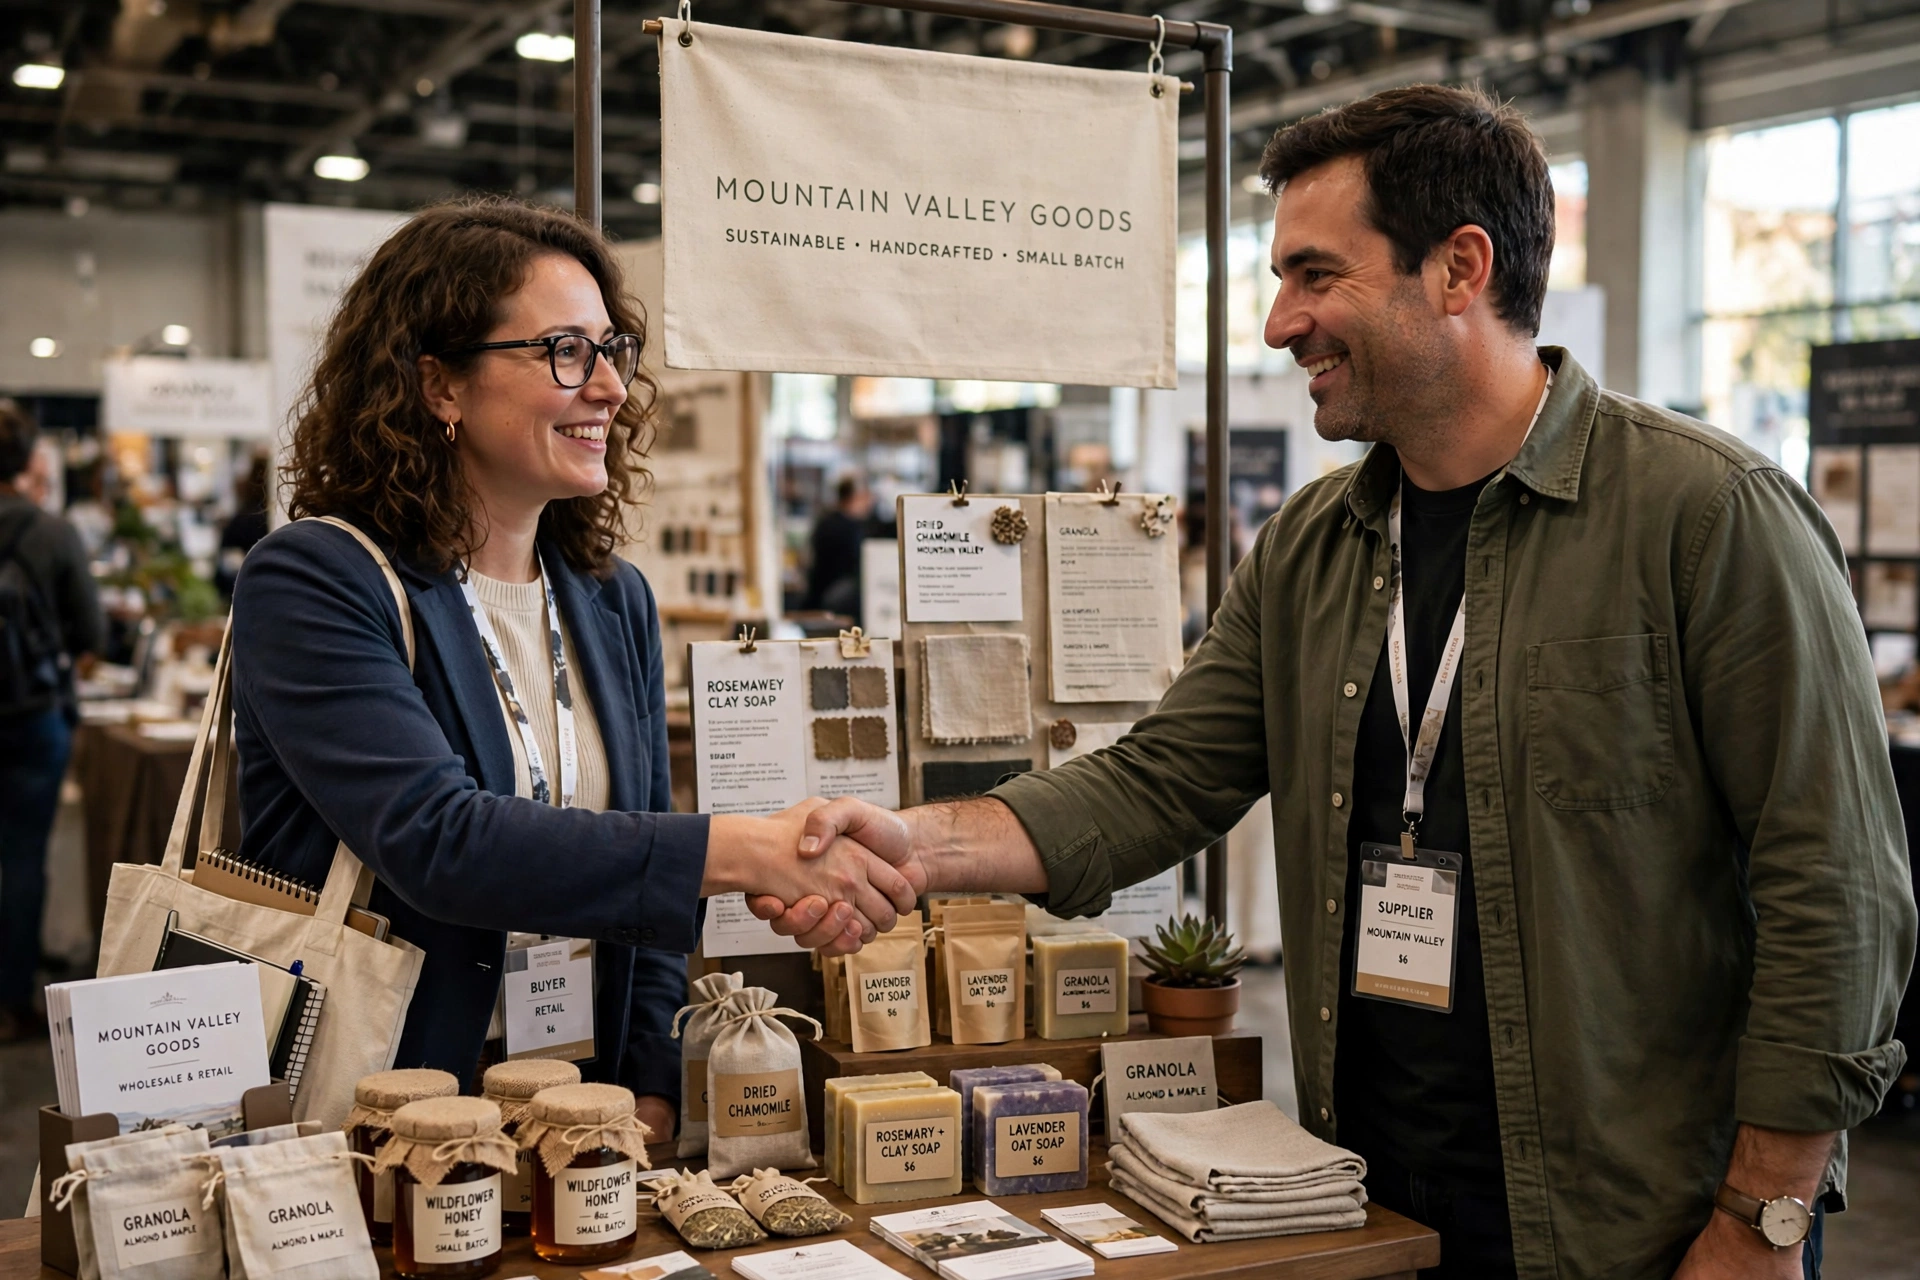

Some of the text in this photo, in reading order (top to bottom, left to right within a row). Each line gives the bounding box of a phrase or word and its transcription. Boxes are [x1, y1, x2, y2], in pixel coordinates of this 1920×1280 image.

[716, 175, 1133, 232] MOUNTAIN VALLEY GOODS
[725, 228, 1125, 270] SUSTAINABLE HANDCRAFTED SMALL BATCH
[1060, 527, 1099, 536] GRANOLA
[708, 679, 784, 692] ROSEMAWEY
[708, 695, 776, 708] CLAY SOAP
[1378, 901, 1434, 920] SUPPLIER
[1366, 927, 1445, 947] MOUNTAIN VALLEY
[1398, 954, 1408, 964] $6
[530, 977, 566, 994] BUYER
[866, 976, 911, 990] LAVENDER
[968, 974, 1008, 986] LAVENDER
[1064, 975, 1110, 986] GRANOLA
[868, 990, 911, 1003] OAT SOAP
[970, 986, 1006, 996] OAT SOAP
[535, 1002, 565, 1016] RETAIL
[888, 1008, 897, 1017] $6
[98, 1012, 241, 1043] MOUNTAIN VALLEY
[546, 1024, 556, 1034] $6
[146, 1037, 200, 1056] GOODS
[1126, 1062, 1196, 1079] GRANOLA
[118, 1066, 234, 1092] WHOLESALE & RETAIL
[744, 1085, 776, 1099] DRIED
[1126, 1090, 1165, 1100] ALMOND
[1177, 1086, 1206, 1096] MAPLE
[728, 1100, 791, 1118] CHAMOMILE
[876, 1126, 935, 1142] ROSEMARY
[1010, 1121, 1066, 1136] LAVENDER
[882, 1142, 940, 1158] CLAY SOAP
[1012, 1136, 1064, 1152] OAT SOAP
[904, 1162, 916, 1172] $6
[1032, 1156, 1044, 1166] $6
[566, 1171, 631, 1192] WILDFLOWER
[426, 1188, 494, 1210] WILDFLOWER
[586, 1190, 620, 1208] HONEY
[124, 1208, 190, 1232] GRANOLA
[268, 1200, 334, 1224] GRANOLA
[444, 1208, 482, 1225] HONEY
[576, 1220, 626, 1234] SMALL BATCH
[124, 1232, 160, 1247] ALMOND
[171, 1224, 196, 1238] MAPLE
[272, 1235, 308, 1251] ALMOND
[318, 1228, 344, 1241] MAPLE
[435, 1238, 488, 1252] SMALL BATCH
